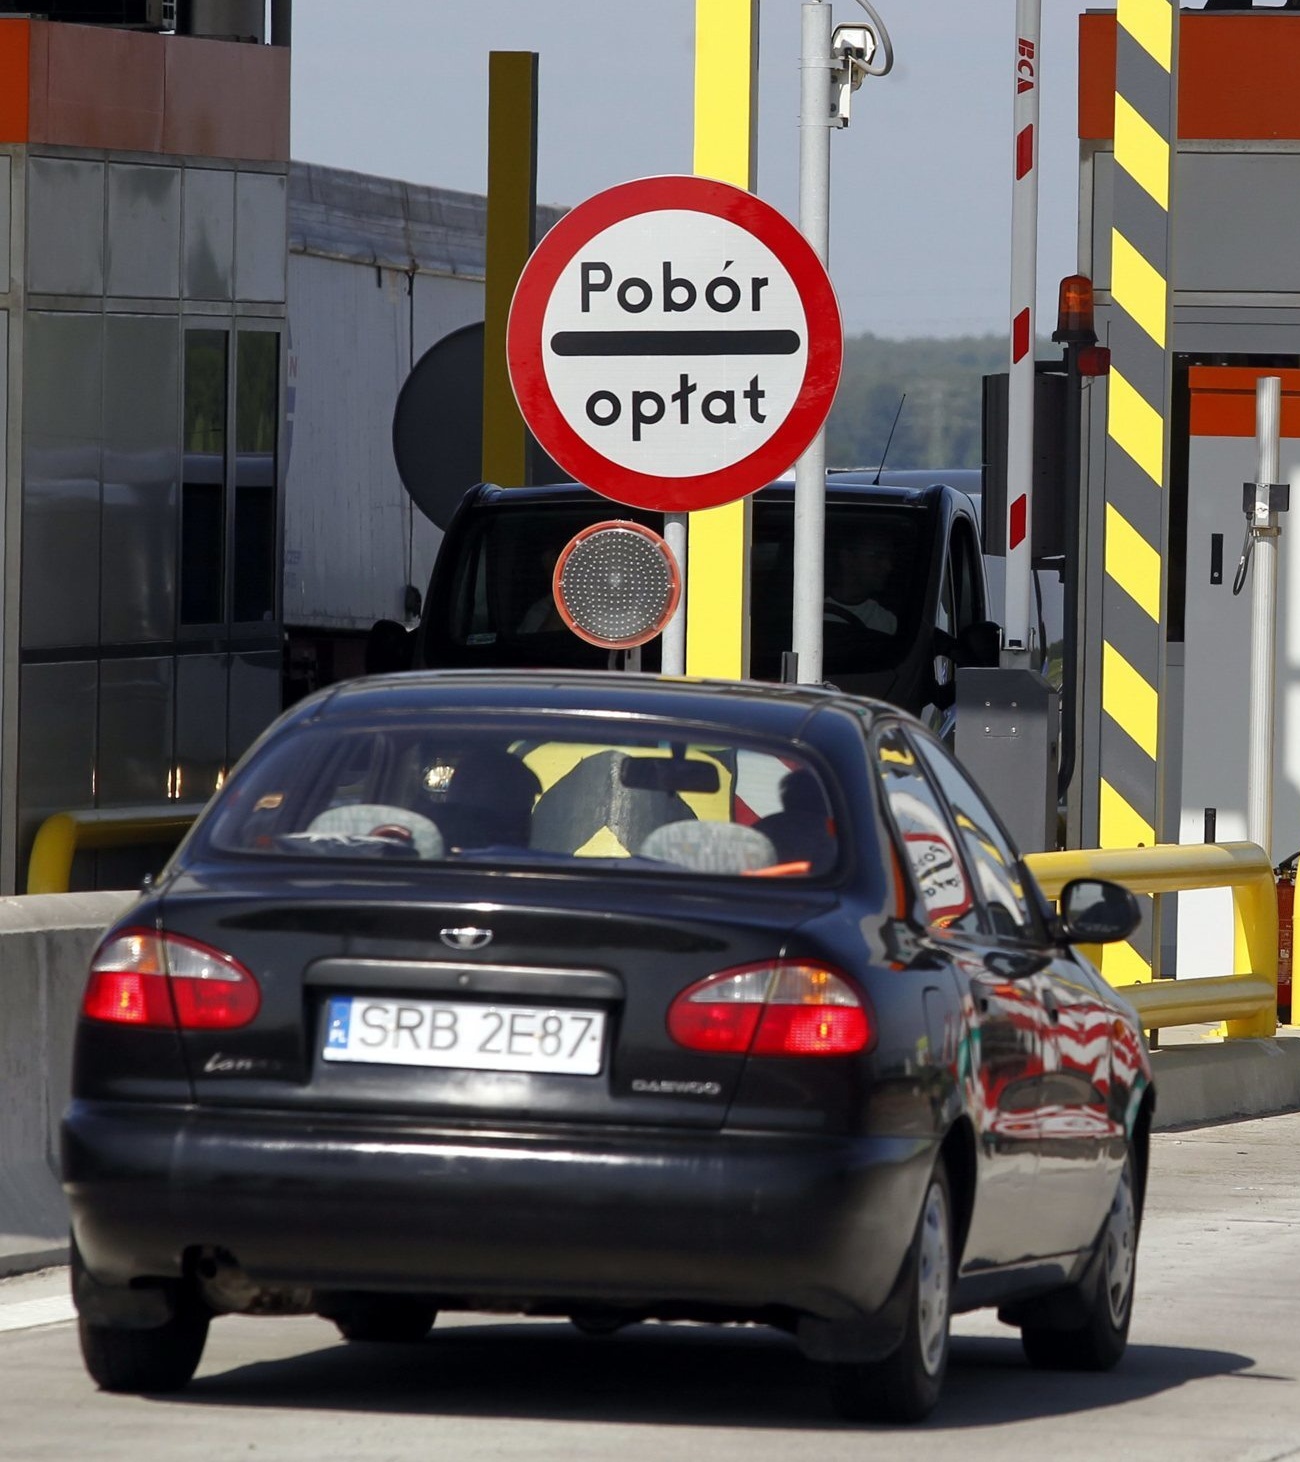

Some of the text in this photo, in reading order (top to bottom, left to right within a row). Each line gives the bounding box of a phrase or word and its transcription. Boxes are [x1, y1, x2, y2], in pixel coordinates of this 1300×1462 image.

[581, 260, 768, 313] Pobór
[585, 373, 767, 441] opłat
[359, 1006, 594, 1058] SRB 2E87
